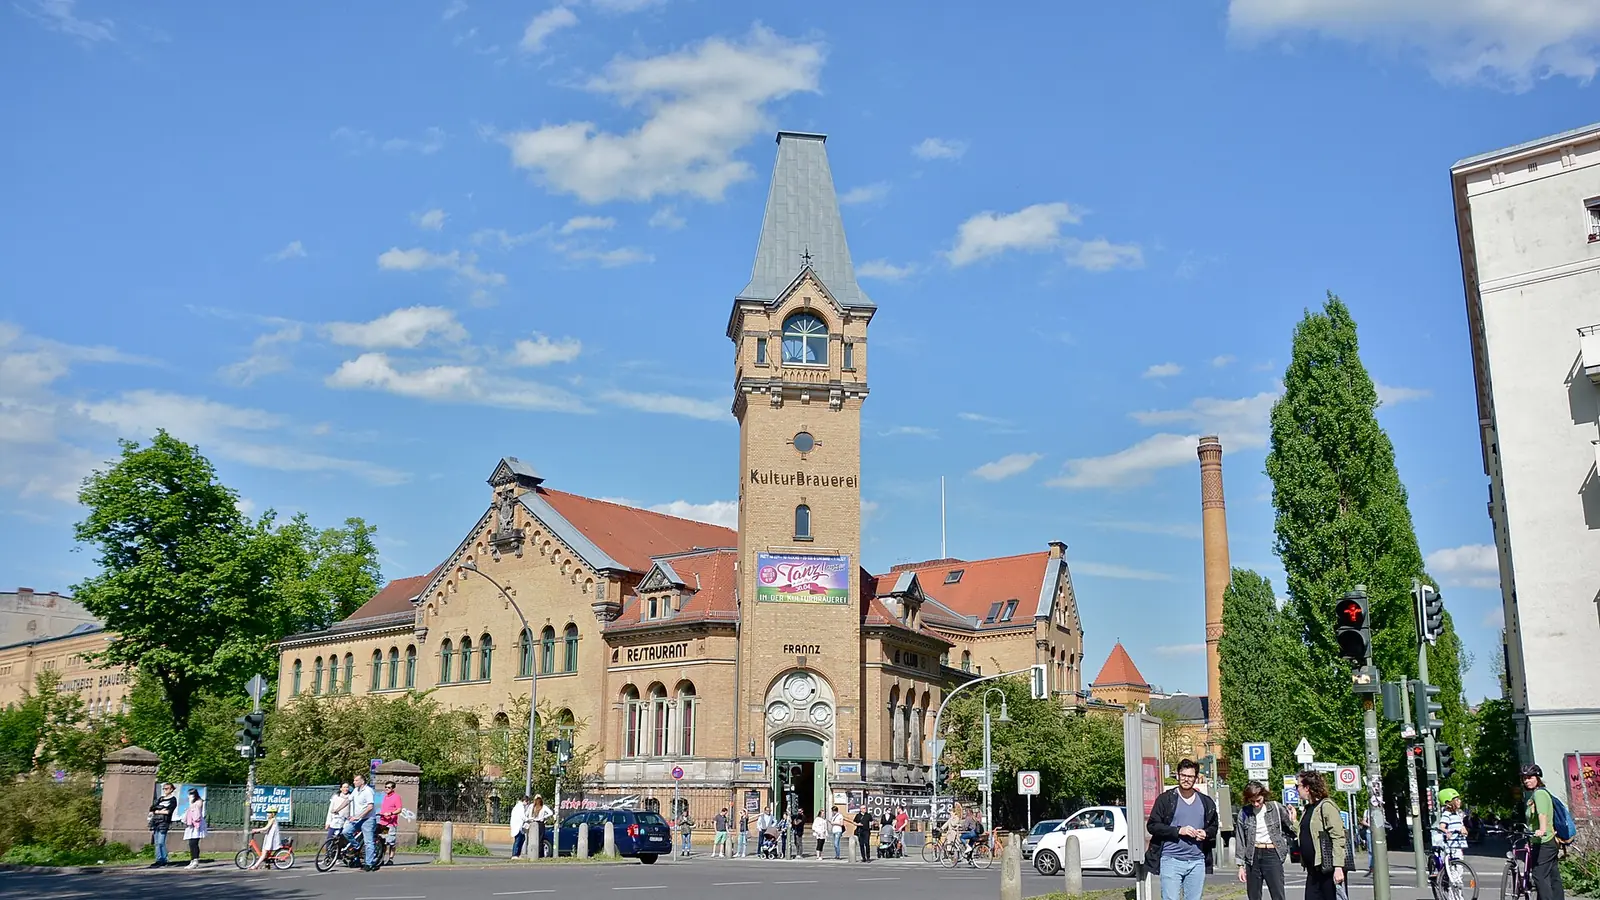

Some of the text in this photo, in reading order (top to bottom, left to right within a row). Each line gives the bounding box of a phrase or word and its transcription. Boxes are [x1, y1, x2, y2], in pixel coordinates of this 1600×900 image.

[750, 469, 858, 488] KulturBrauerei
[770, 594, 784, 602] DER
[627, 642, 688, 663] RESTAURANT
[783, 644, 821, 655] FRANNZ
[1343, 772, 1352, 780] 30
[867, 796, 907, 807] POEMS
